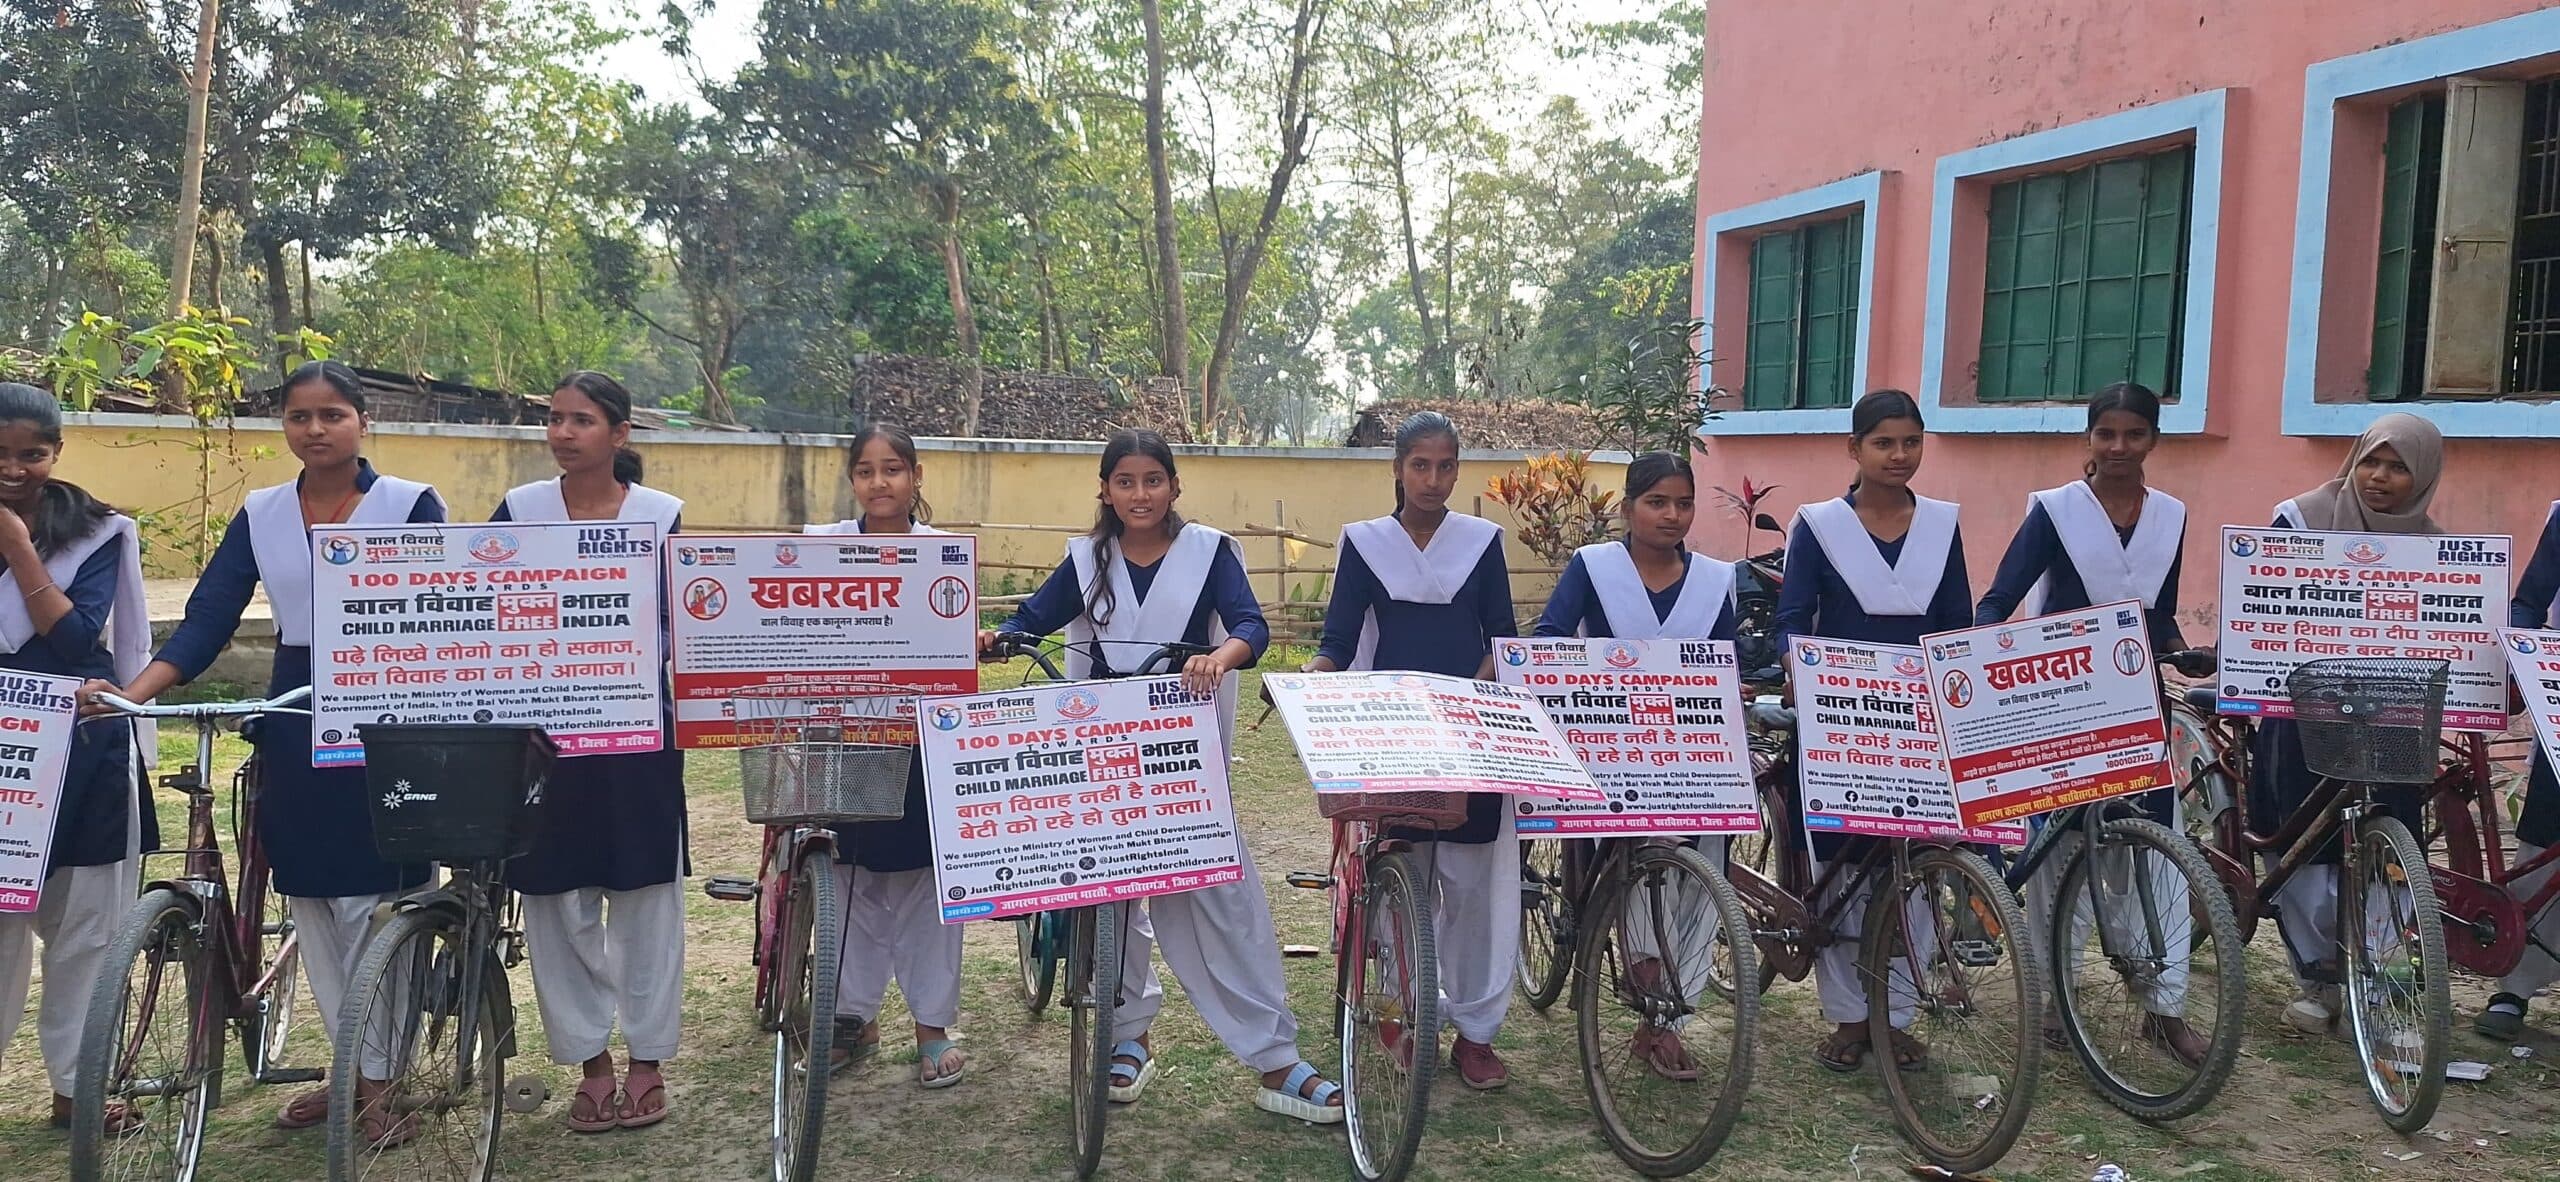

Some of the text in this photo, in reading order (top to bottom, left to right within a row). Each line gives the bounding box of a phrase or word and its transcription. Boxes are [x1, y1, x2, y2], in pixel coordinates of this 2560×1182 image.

[365, 534, 445, 546] बाल विवाह
[578, 528, 630, 541] JUST
[366, 545, 445, 558] मुक्त भारत
[578, 540, 653, 554] RIGHTS
[942, 545, 960, 554] JUST
[2438, 540, 2486, 551] JUST
[2437, 551, 2507, 563] RIGHTS
[349, 567, 627, 587] 100 DAYS CAMPAIGN
[2249, 564, 2481, 584] 100 DAYS CAMPAIGN
[749, 576, 902, 611] खबरदार
[342, 593, 630, 615] बाल विवाह मुक्त भारत
[342, 614, 630, 635] CHILD MARRIAGE FREE INDIA
[761, 618, 778, 627] बाल
[780, 616, 804, 627] विवाह
[806, 617, 821, 626] एक
[854, 617, 882, 626] अपराध
[2369, 608, 2483, 623] FREE INDIA
[2230, 620, 2256, 633] घर
[2262, 622, 2288, 635] घर
[2293, 620, 2341, 637] शिक्षा
[2350, 626, 2377, 639] का
[2386, 625, 2419, 641] दीप
[374, 643, 429, 662] लिखे
[437, 641, 491, 660] लोगो
[500, 644, 531, 658] का
[538, 639, 562, 657] हो
[567, 640, 643, 656] समाज,
[1680, 644, 1715, 654] JUST
[1680, 653, 1734, 665] RIGHTS
[333, 672, 377, 688] बाल
[386, 668, 448, 685] विवाह
[455, 667, 486, 682] का
[493, 666, 513, 680] न
[522, 661, 546, 679] हो
[1983, 646, 2094, 691] खबरदार
[0, 677, 52, 693] JUST
[1620, 674, 1718, 686] CAMPAIGN
[1817, 674, 1901, 692] 100 DAYS
[0, 690, 74, 709] RIGHTS
[343, 693, 386, 702] support
[390, 691, 407, 699] the
[411, 690, 458, 699] Ministry
[475, 687, 515, 696] Women
[519, 686, 538, 694] and
[542, 685, 569, 693] Child
[1998, 697, 2011, 706] बाल
[2012, 693, 2029, 704] विवाह
[967, 697, 1034, 710] बाल विवाह
[402, 706, 602, 723] JustRights @JustRightsIndia
[968, 707, 1036, 725] मुक्त भारत
[1564, 714, 1725, 725] MARRIAGE FREE INDIA
[956, 735, 1000, 749] 100
[1008, 730, 1068, 746] DAYS
[1075, 716, 1194, 738] CAMPAIGN
[1624, 730, 1658, 744] नहीं
[1664, 729, 1676, 743] है
[1826, 732, 1939, 752] हर कोई अगर
[953, 739, 1199, 777] बाल विवाह मुक्त भारत
[1807, 749, 1932, 770] बाल विवाह बन्द
[2105, 753, 2154, 768] 18001027222
[955, 760, 1202, 796] CHILD MARRIAGE FREE INDIA
[2051, 770, 2069, 779] 1098
[957, 780, 1207, 819] बाल विवाह नहीं है भला,
[958, 820, 997, 840] बेटी
[1007, 816, 1037, 834] को
[1045, 812, 1075, 829] रहे
[1083, 809, 1103, 824] हो
[1110, 807, 1147, 825] तुम
[946, 858, 1005, 871] Government
[1099, 842, 1125, 851] Vivah
[1128, 839, 1151, 848] Mukt
[1154, 835, 1185, 845] Bharat
[1188, 830, 1232, 843] campaign
[1017, 847, 1189, 875] JustRights @JustRightsIndia
[969, 854, 1235, 895] JustRightsIndia www.justrightsforchildren.org
